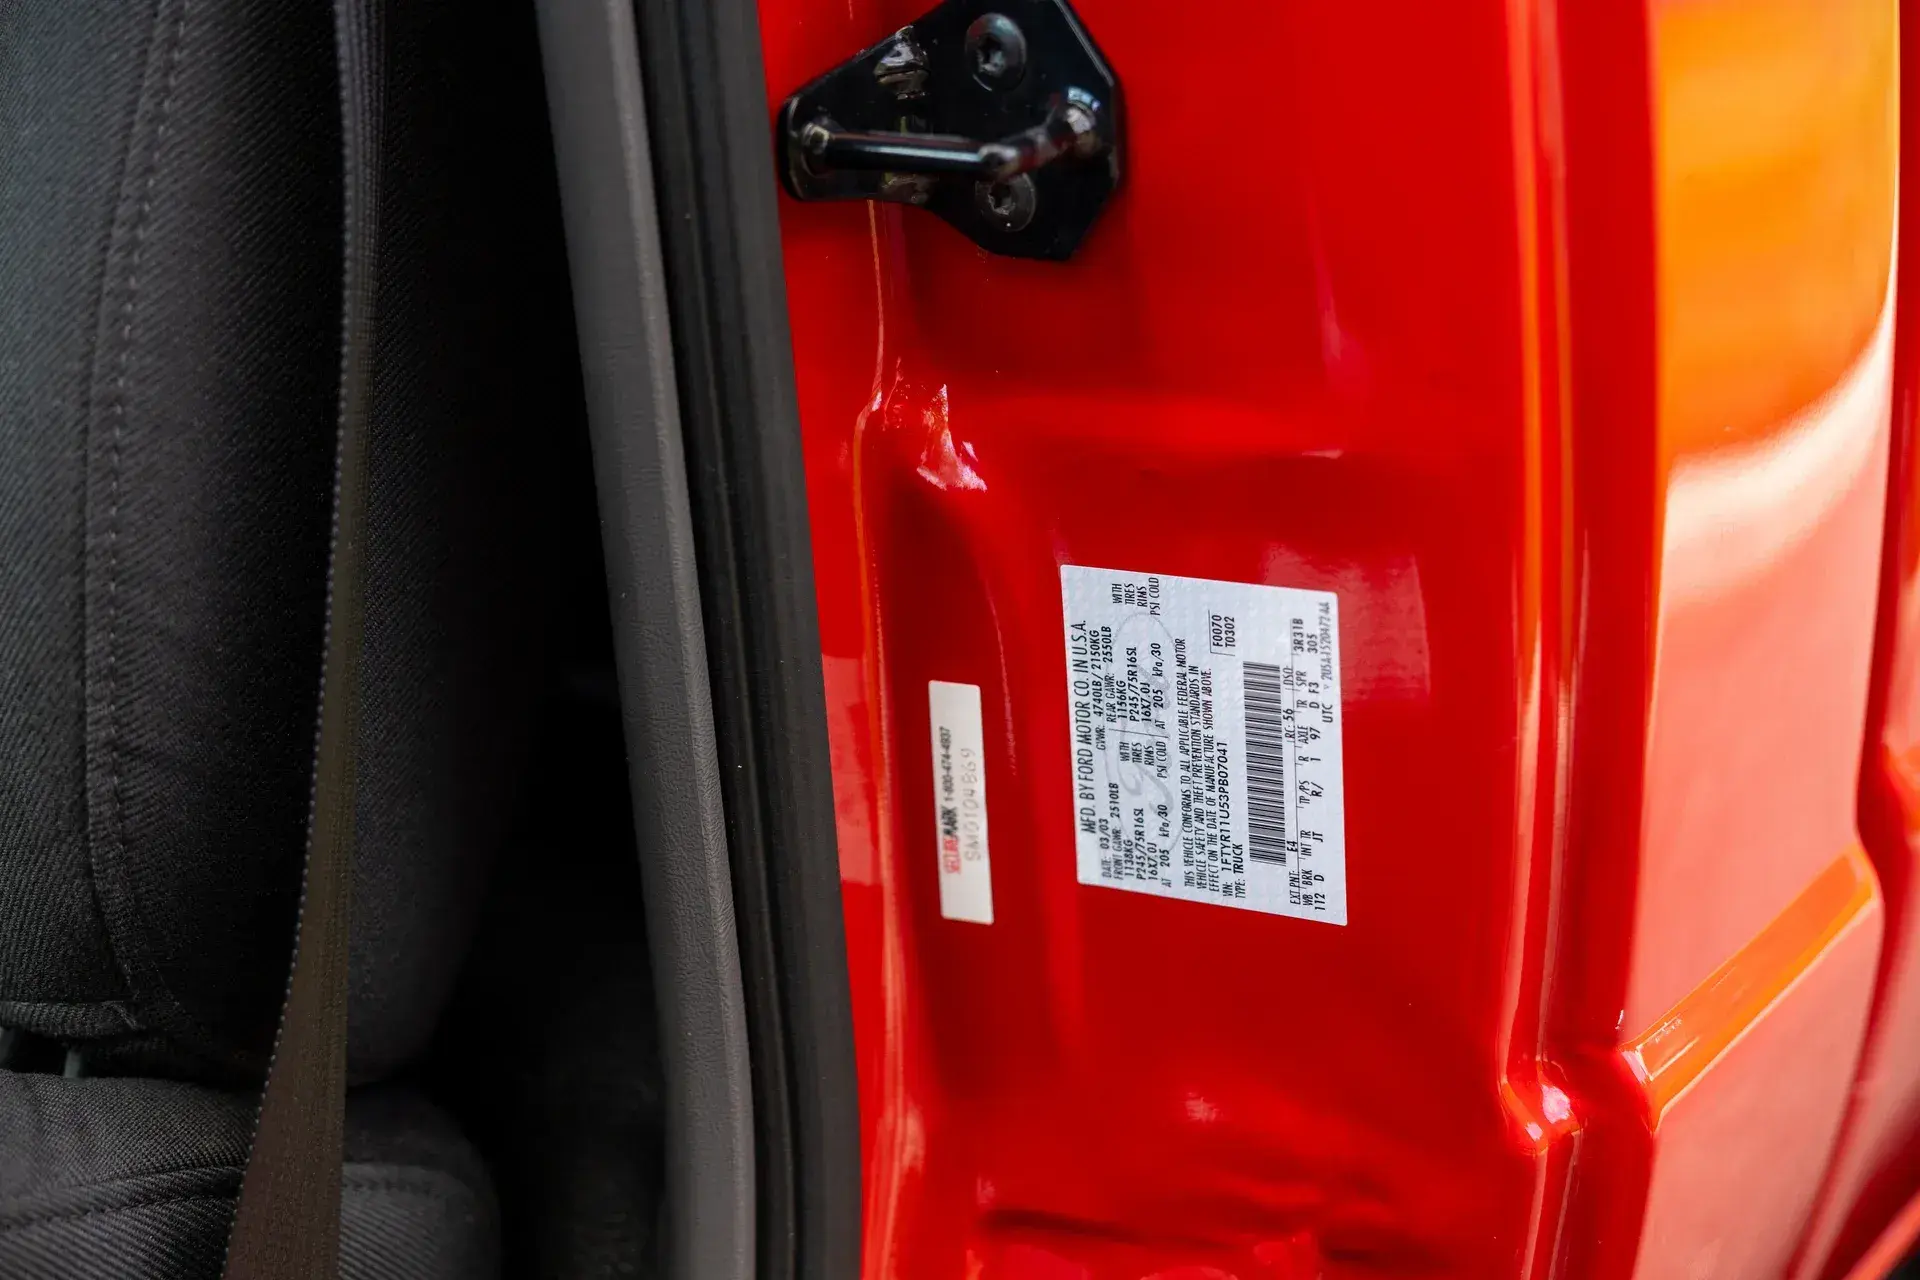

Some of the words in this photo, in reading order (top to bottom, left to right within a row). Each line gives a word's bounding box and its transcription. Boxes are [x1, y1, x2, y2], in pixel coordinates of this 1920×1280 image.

[1112, 583, 1122, 603] WITH
[1124, 583, 1135, 604] TIRES
[1136, 586, 1147, 607] RIMS
[1148, 577, 1159, 598] COLD
[1149, 602, 1160, 615] PSI
[1071, 620, 1087, 655] U.S.A.
[1211, 615, 1223, 646] F0070
[1224, 616, 1235, 647] T0302
[1101, 626, 1112, 662] 2550LB
[1175, 638, 1186, 667] MOTOR
[1306, 634, 1318, 653] 305
[1072, 659, 1088, 673] IN
[1150, 643, 1163, 676] kPa/30
[1188, 665, 1198, 675] IN
[1295, 670, 1306, 686] SPR
[1073, 678, 1089, 696] CO.
[1104, 673, 1115, 698] GAWR:
[1126, 647, 1139, 721] P245/75R16SL
[1176, 672, 1188, 706] FEDERAL
[1200, 669, 1212, 696] ABOVE.
[1308, 682, 1319, 693] F3
[1116, 680, 1127, 718] 1156KG
[1140, 682, 1151, 721] 16X7.0J
[1152, 689, 1163, 708] 205
[1189, 679, 1200, 725] STANDARDS
[1296, 699, 1307, 708] TR
[1308, 701, 1319, 709] D
[1105, 702, 1116, 722] REAR
[1202, 700, 1213, 729] SHOWN
[1282, 708, 1294, 721] 56
[1321, 703, 1333, 723] UTC
[1075, 701, 1091, 744] MOTOR
[1154, 719, 1165, 729] AT
[1178, 710, 1189, 755] APPLICABLE
[1095, 725, 1105, 750] GVWR:
[1297, 725, 1308, 744] AXLE
[1309, 727, 1320, 739] 97
[1119, 741, 1129, 761] WITH
[1131, 742, 1142, 763] TIRES
[1143, 745, 1154, 765] RIMS
[1155, 741, 1166, 761] COLD
[1191, 729, 1202, 778] PREVENTION
[1077, 748, 1093, 781] FORD
[1156, 765, 1167, 778] PSI
[1180, 760, 1190, 772] ALL
[1203, 734, 1215, 792] MANUFACTURE
[1180, 775, 1191, 784] TO
[1310, 782, 1323, 797] R/
[1079, 784, 1094, 800] BY
[1108, 783, 1120, 818] 2510LB
[1192, 780, 1203, 803] THEFT
[1205, 796, 1216, 806] OF
[1298, 780, 1311, 804] TP/PS
[1181, 789, 1192, 832] CONFORMS
[1194, 808, 1204, 824] AND
[1217, 743, 1231, 870] 1FTYR11U53PB07041
[1080, 806, 1096, 833] MFD.
[1157, 804, 1170, 837] kPa/30
[1206, 810, 1217, 829] DATE
[1098, 818, 1110, 849] 03/03
[1194, 826, 1205, 855] SAFETY
[1206, 832, 1217, 845] THE
[1300, 830, 1311, 838] TR
[1312, 831, 1323, 842] JT
[1133, 808, 1146, 880] P245/75R16SL
[1183, 837, 1194, 866] VEHICLE
[1286, 840, 1298, 853] E4
[1300, 842, 1311, 856] INT
[1123, 839, 1134, 875] 1138KG
[1147, 842, 1157, 879] 16X7.0J
[1159, 849, 1170, 867] 205
[1207, 849, 1218, 861] ON
[1232, 843, 1243, 873] TRUCK
[1101, 857, 1111, 878] DATE:
[1113, 854, 1123, 879] FRONT
[1195, 859, 1207, 888] VEHICLE
[1161, 877, 1171, 887] AT
[1184, 871, 1194, 886] THIS
[1208, 864, 1219, 892] EFFECT
[1289, 870, 1300, 888] PNT:
[1301, 869, 1312, 885] BRK
[1222, 882, 1232, 896] VIN:
[1234, 879, 1245, 898] TYPE:
[1289, 890, 1301, 904] EXT
[1302, 894, 1313, 905] WB
[1314, 893, 1325, 910] 112
